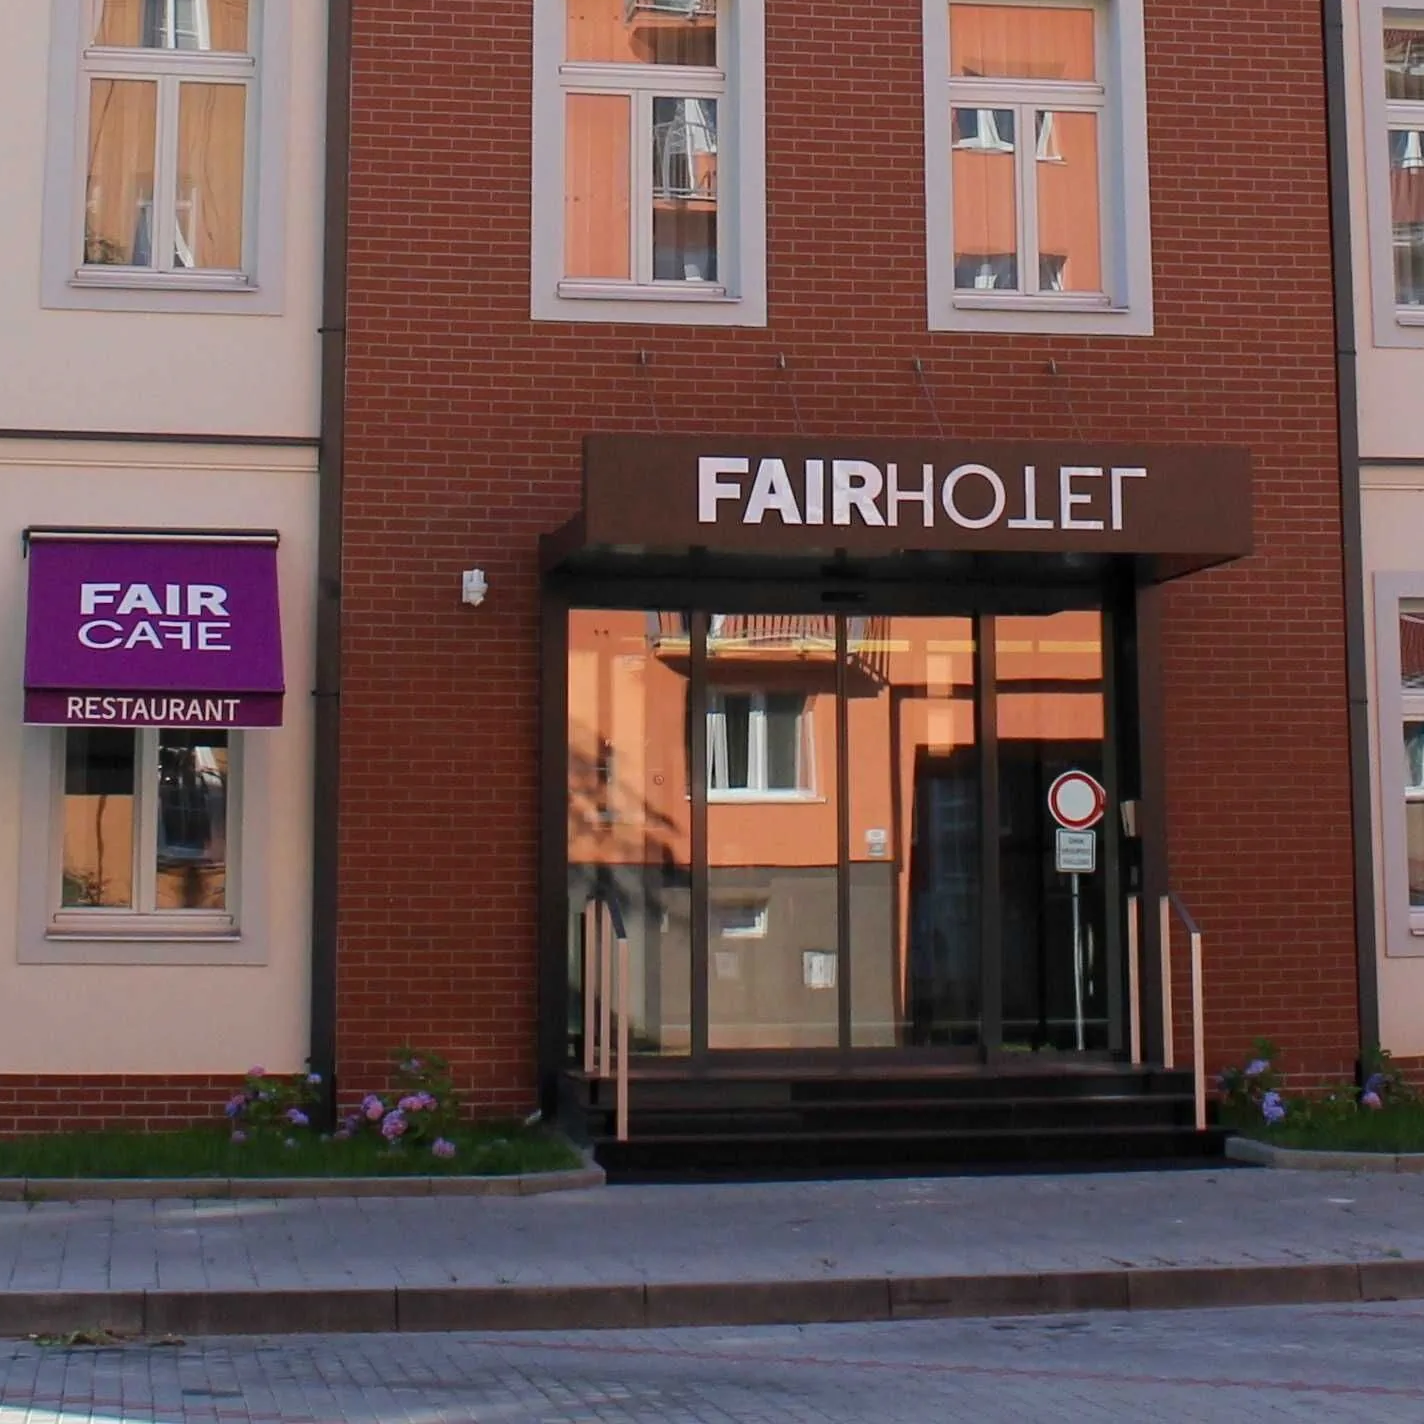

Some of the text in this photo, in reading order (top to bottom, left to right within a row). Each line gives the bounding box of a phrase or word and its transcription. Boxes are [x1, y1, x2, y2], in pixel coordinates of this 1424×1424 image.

[80, 583, 231, 616] FAIR
[78, 619, 232, 651] CAFE
[67, 696, 241, 721] RESTAURANT
